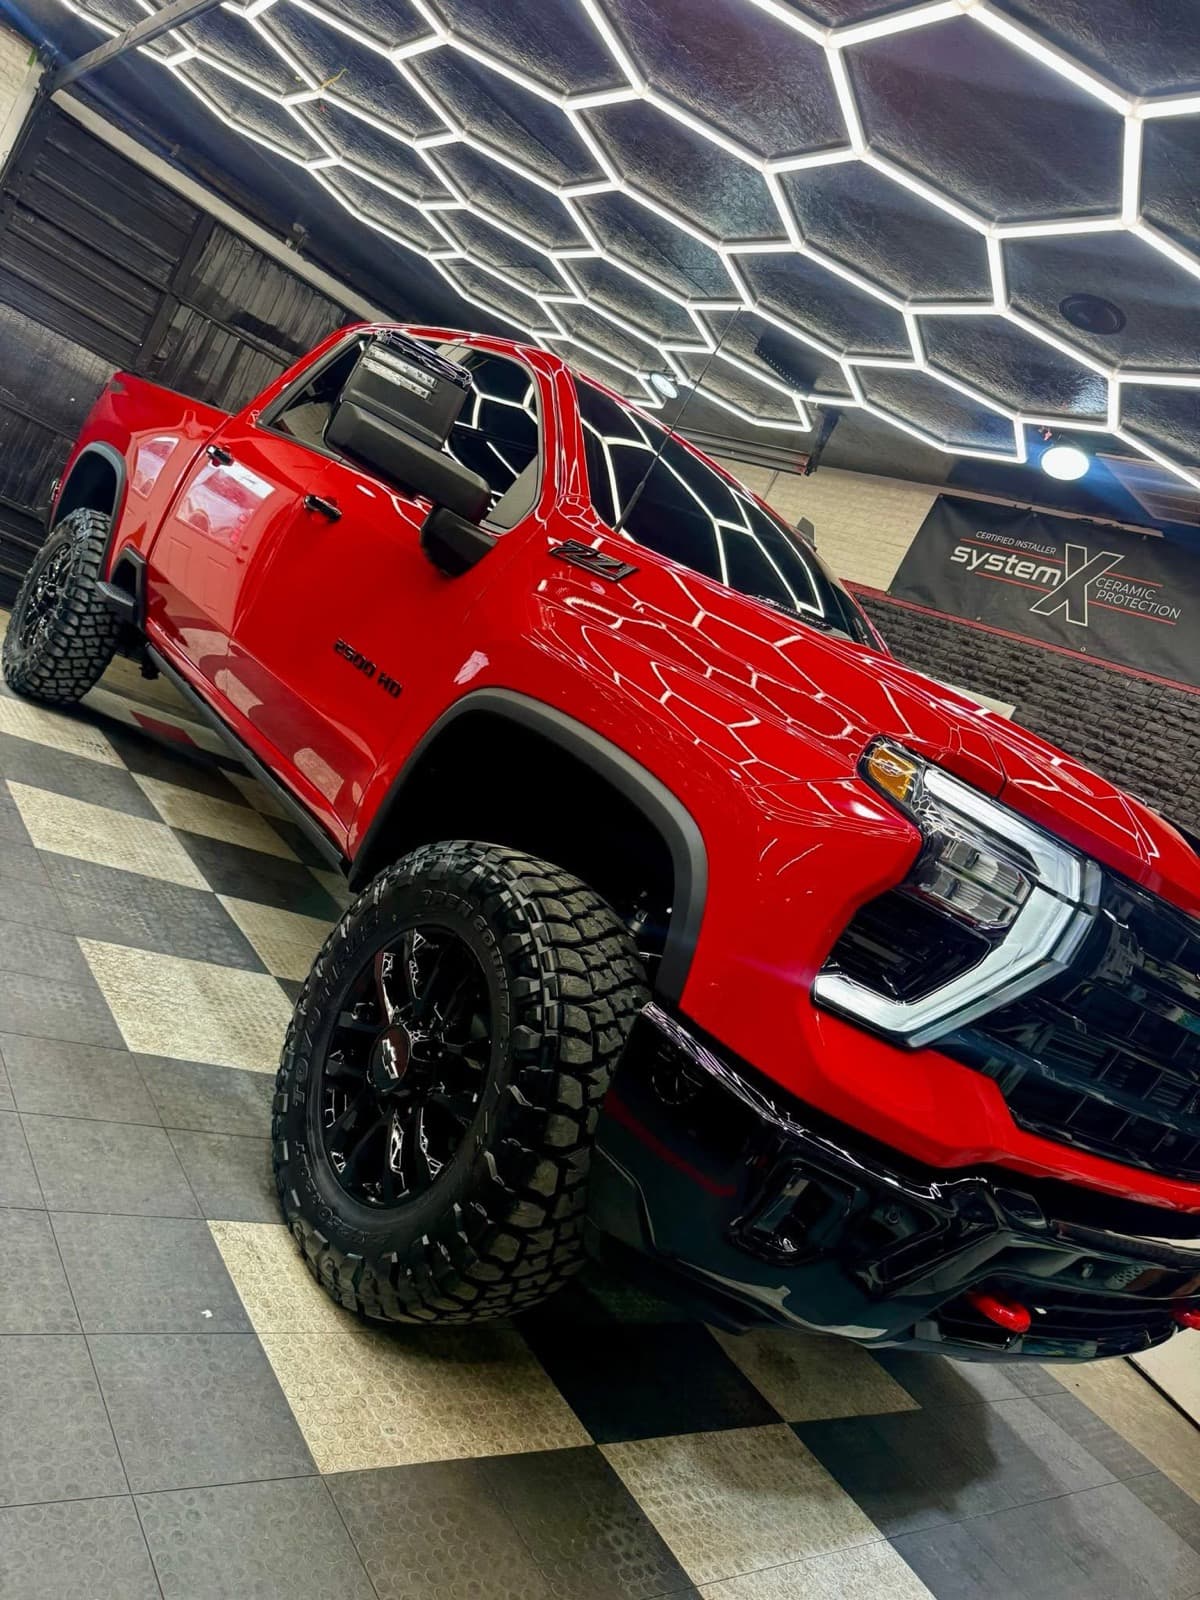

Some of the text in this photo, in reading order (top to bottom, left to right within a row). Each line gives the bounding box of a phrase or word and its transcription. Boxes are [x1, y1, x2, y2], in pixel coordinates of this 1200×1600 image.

[975, 530, 1057, 555] CERTIFIED INSTALLER
[950, 545, 1062, 587] system
[1096, 577, 1157, 601] CERAMIC
[1096, 589, 1182, 620] PROTECTION
[334, 637, 402, 698] 2500 HD
